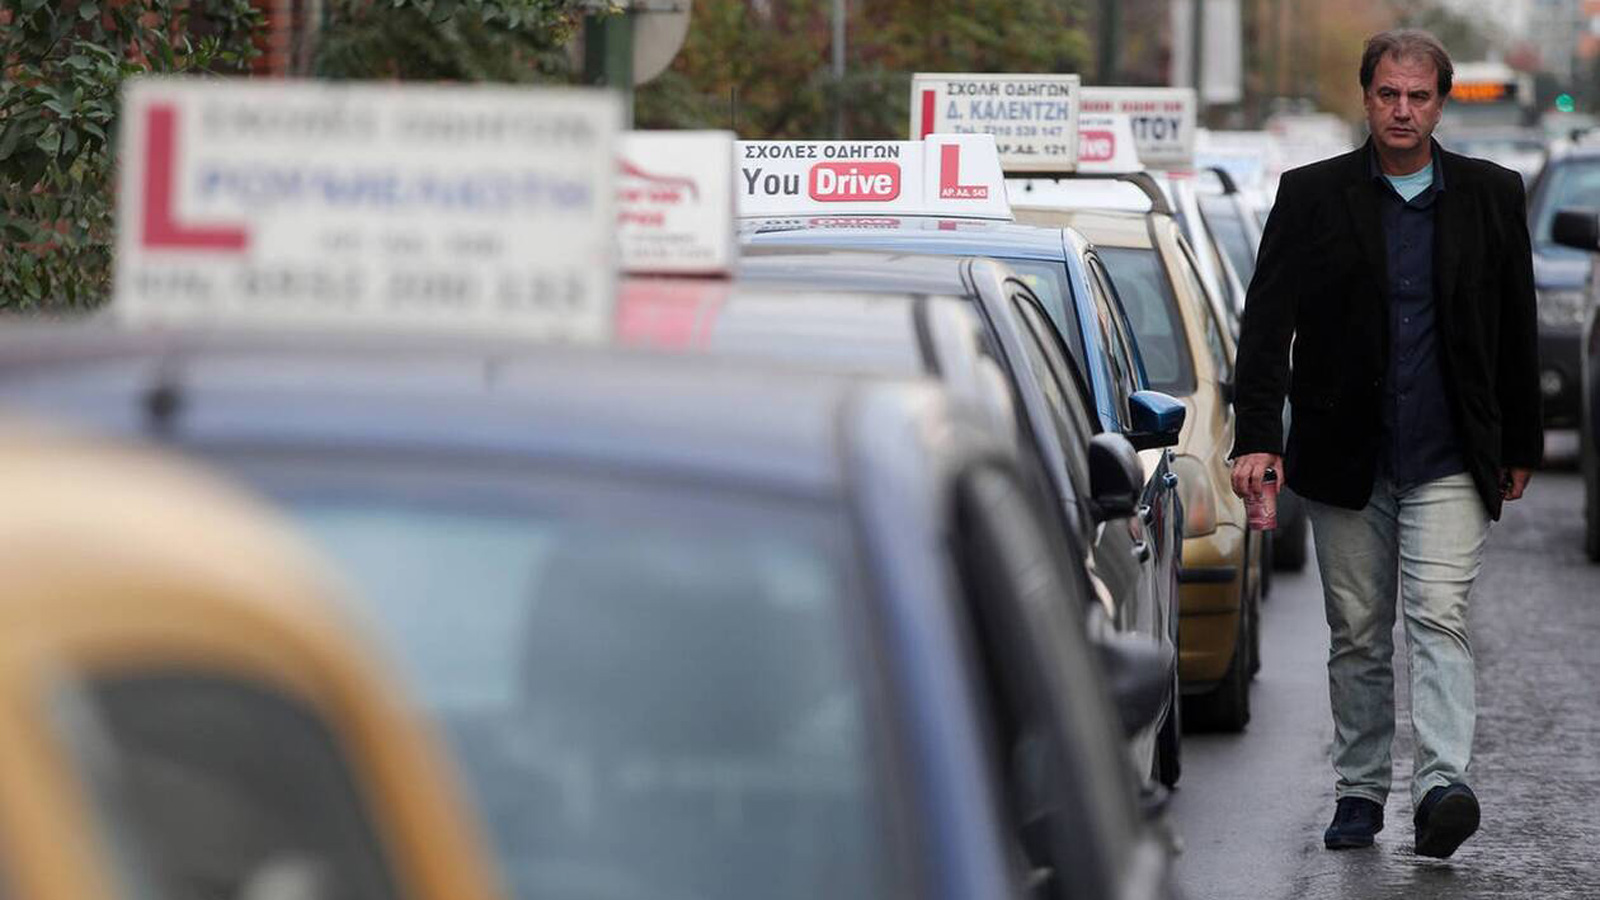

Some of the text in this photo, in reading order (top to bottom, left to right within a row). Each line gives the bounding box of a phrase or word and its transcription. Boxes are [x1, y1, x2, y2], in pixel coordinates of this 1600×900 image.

[947, 83, 1069, 96] ΣΧΟΛΗ ΟΔΗΓΩΝ
[970, 100, 1069, 121] ΚΑΛΕΝΤΖΗ
[745, 145, 900, 159] ΣΧΟΛΕΣ ΟΔΗΓΩΝ
[142, 103, 248, 249] L
[742, 168, 893, 196] You Drive
[940, 144, 989, 199] L
